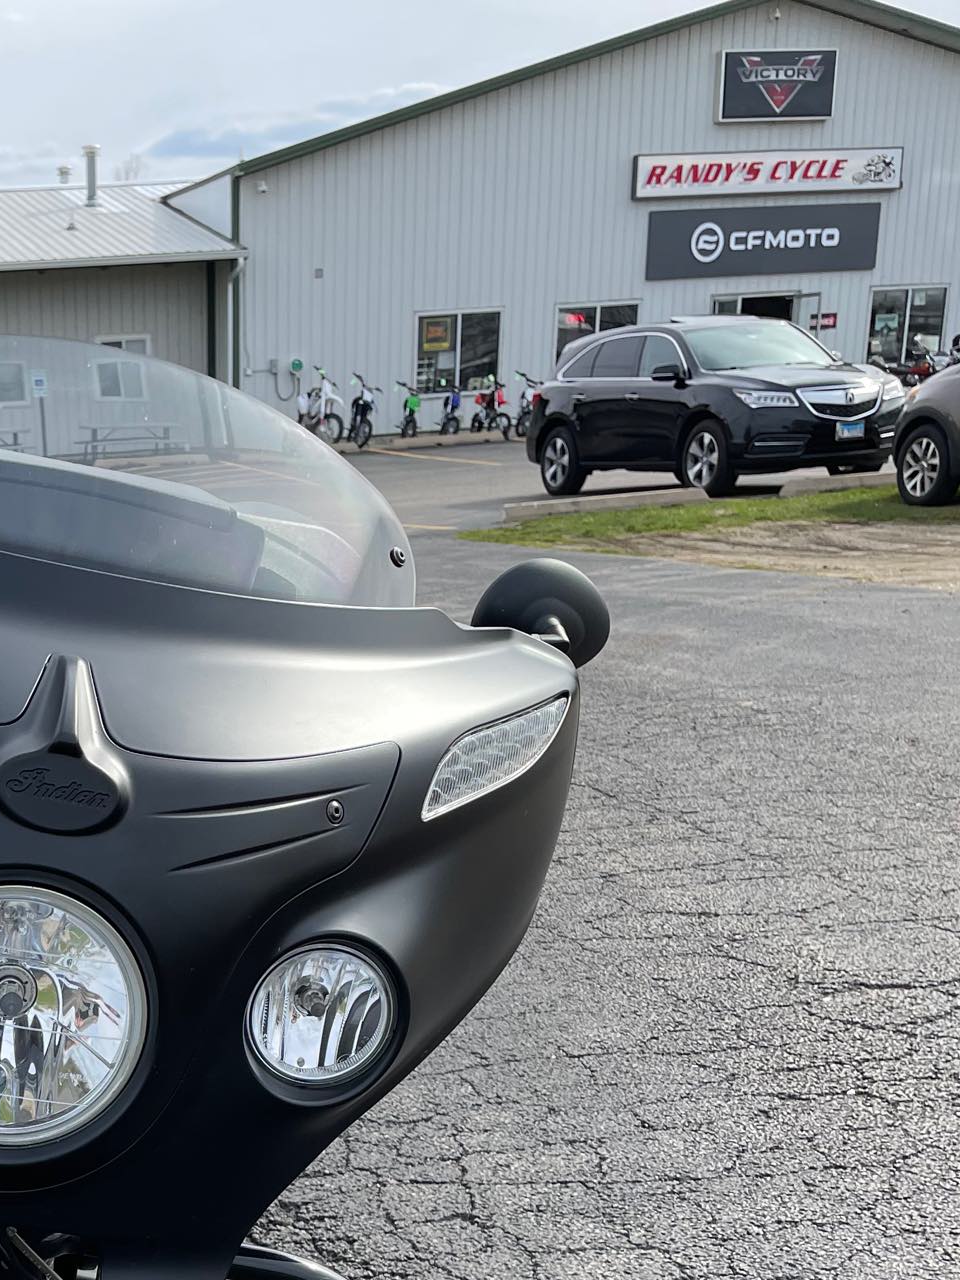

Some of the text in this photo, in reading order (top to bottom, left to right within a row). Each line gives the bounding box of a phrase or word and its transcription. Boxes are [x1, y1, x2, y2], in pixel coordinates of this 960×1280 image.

[741, 66, 821, 80] VICTORY
[645, 159, 848, 186] RANDY'S CYCLE
[729, 228, 840, 251] CFMOTO
